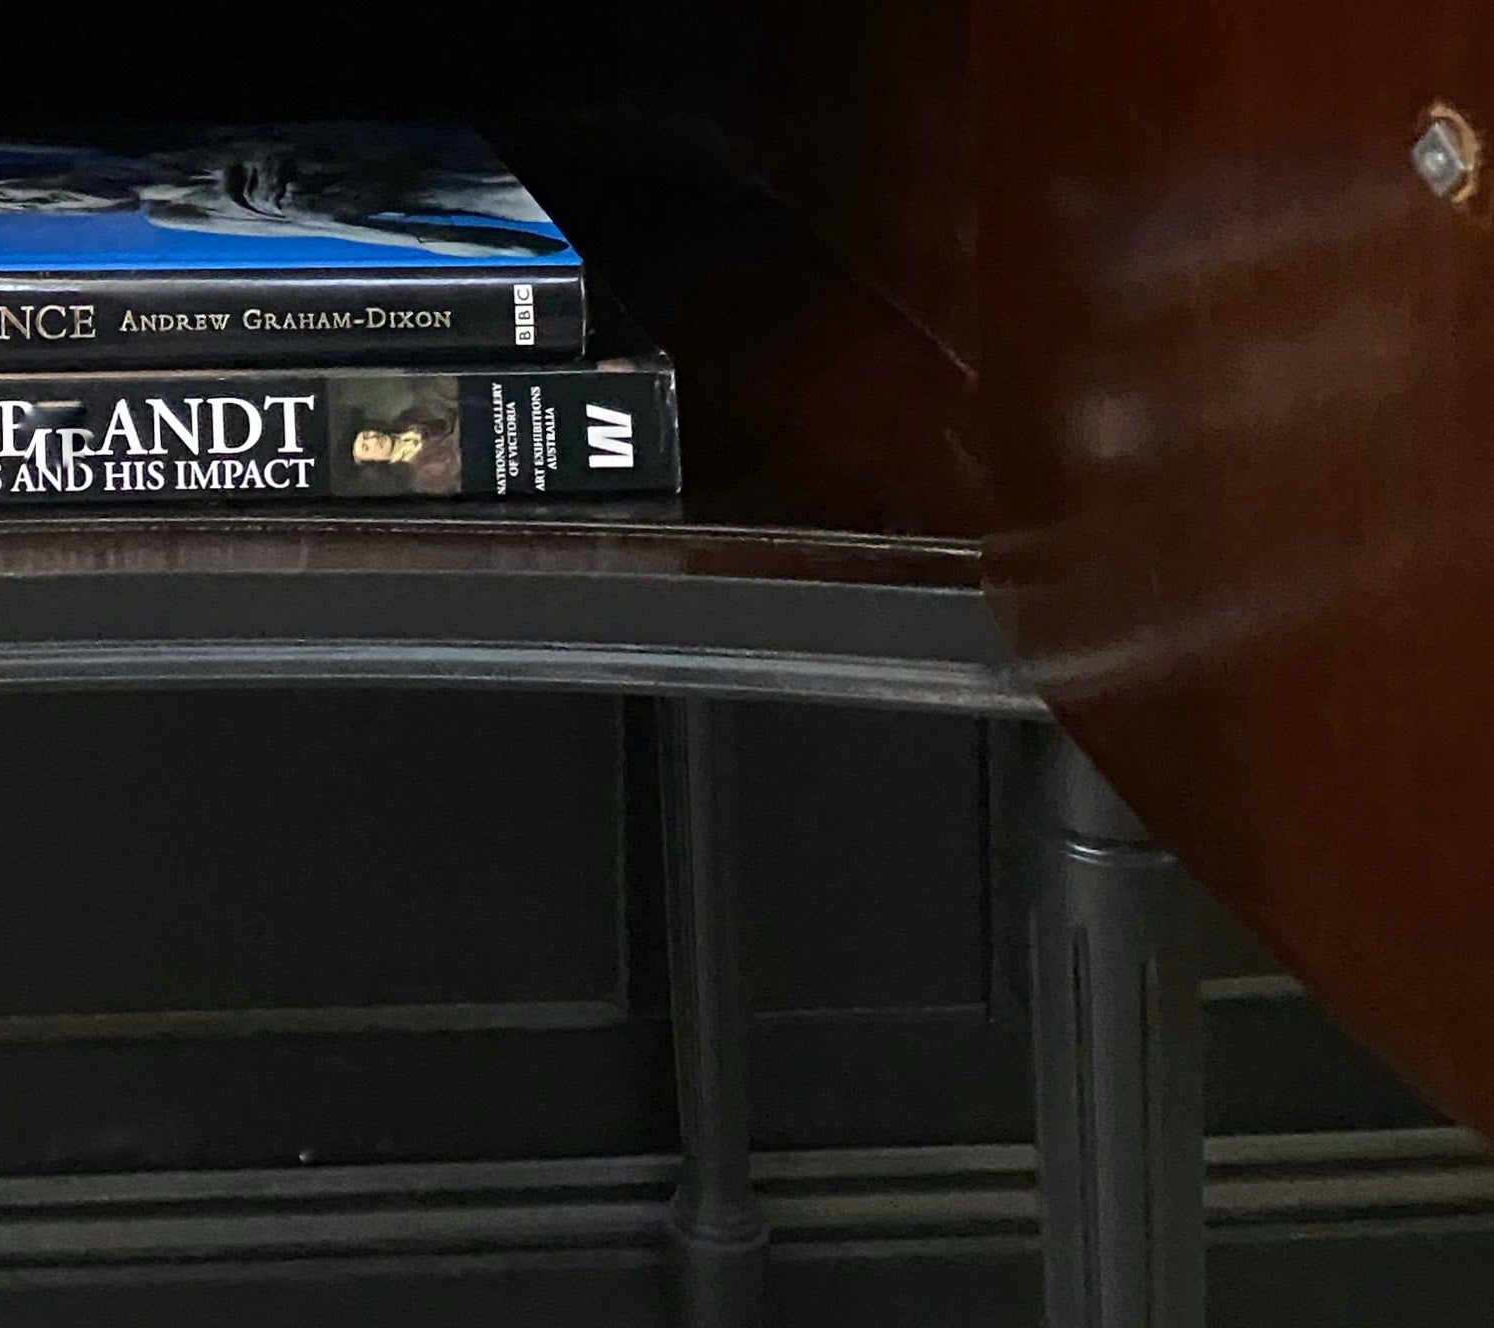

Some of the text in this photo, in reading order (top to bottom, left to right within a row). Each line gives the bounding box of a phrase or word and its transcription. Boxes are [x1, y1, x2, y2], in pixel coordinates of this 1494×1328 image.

[120, 309, 231, 332] ANDREW
[242, 307, 452, 330] GRAHAM-DIXON
[516, 286, 533, 343] BBC
[491, 382, 506, 495] NATIONAL GALLERY
[506, 401, 519, 477] OF VICTORIA
[530, 386, 546, 492] ART EXHIBITIONS
[544, 407, 558, 470] AUSTRALIA
[10, 463, 93, 493] AND
[103, 460, 166, 491] HIS
[174, 457, 315, 490] IMPACT
